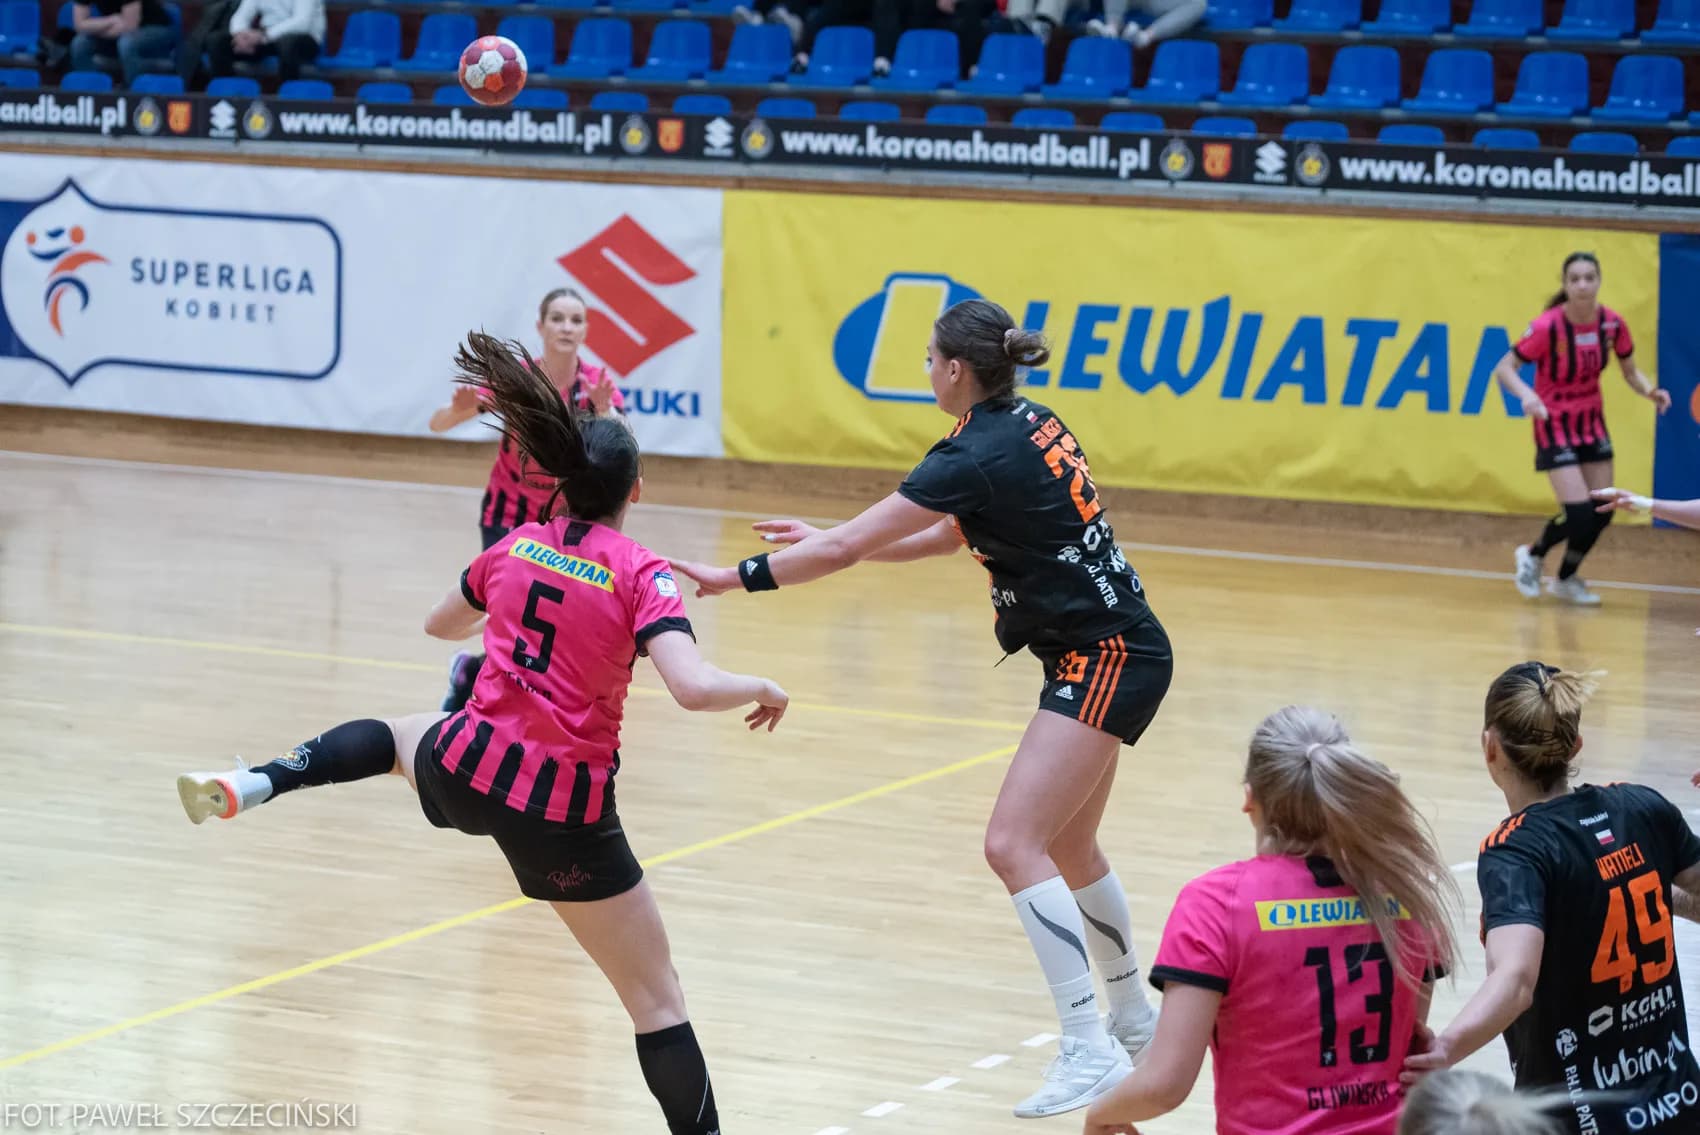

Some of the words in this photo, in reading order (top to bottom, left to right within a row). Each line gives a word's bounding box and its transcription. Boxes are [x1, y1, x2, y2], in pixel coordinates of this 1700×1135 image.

[279, 105, 613, 153] www.koronahandball.pl
[781, 125, 1150, 178] www.koronahandball.pl
[130, 257, 316, 296] SUPERLIGA
[165, 297, 276, 323] KOBIET
[530, 546, 610, 586] LEWIATAN
[1095, 575, 1119, 609] PATER
[511, 579, 566, 675] 5
[1300, 898, 1400, 924] LEWIAN
[1591, 870, 1674, 993] 49
[1303, 941, 1395, 1068] 13
